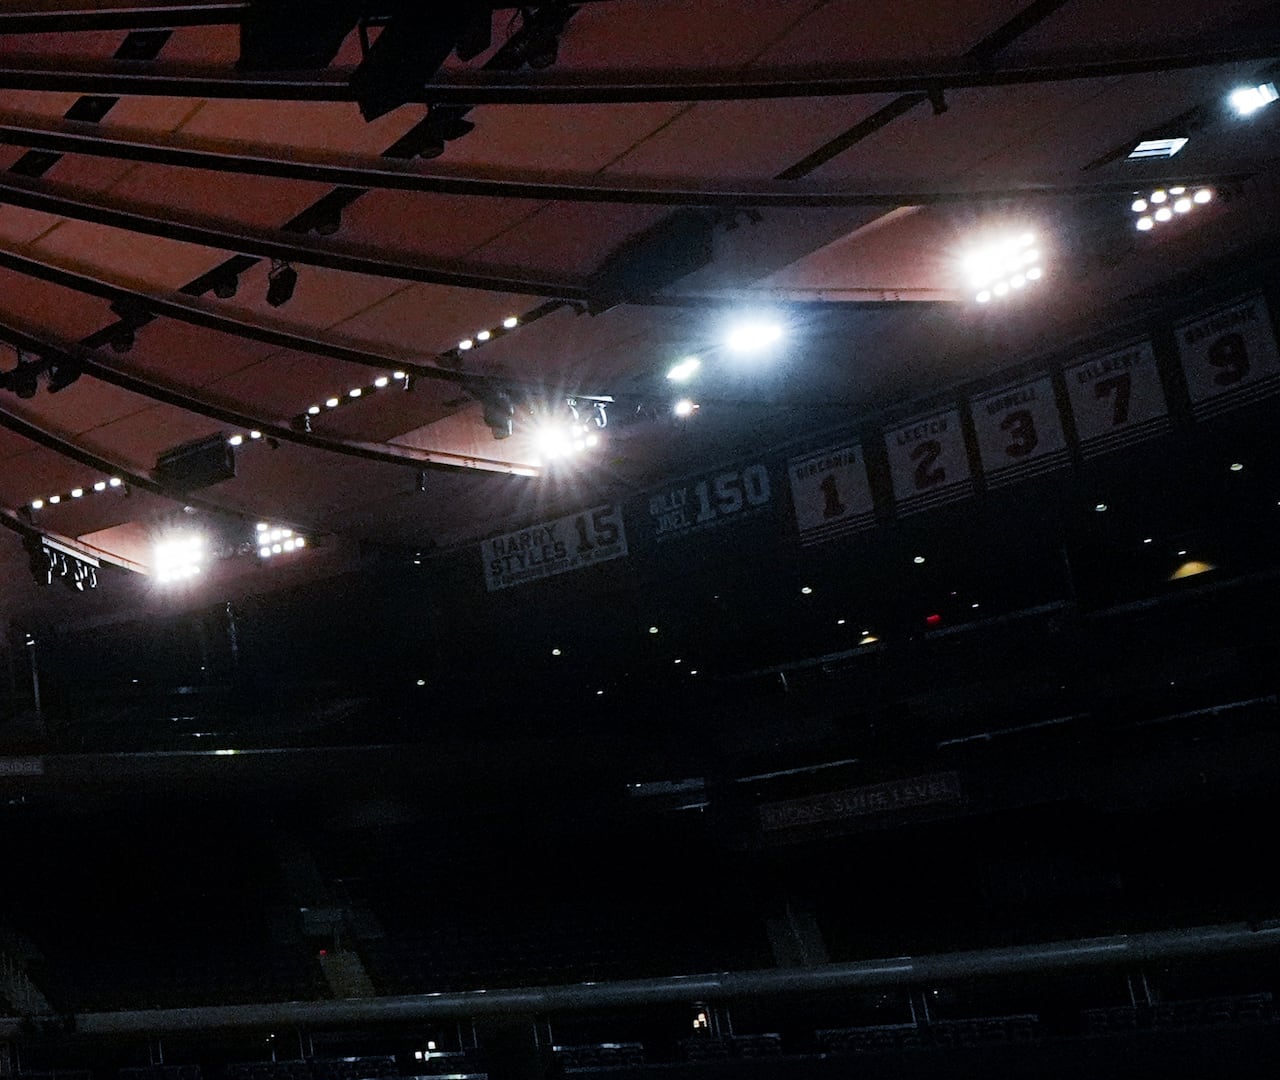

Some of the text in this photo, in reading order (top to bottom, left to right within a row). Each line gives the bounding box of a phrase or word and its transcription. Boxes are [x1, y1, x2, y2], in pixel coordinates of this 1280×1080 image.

[1208, 333, 1251, 386] 9
[1094, 372, 1133, 425] 7
[1000, 409, 1039, 459] 3
[908, 439, 946, 491] 2
[688, 463, 772, 523] 150
[819, 474, 846, 519] 1
[492, 524, 557, 559] HARRY
[575, 508, 619, 554] 15
[489, 541, 567, 576] STYLES
